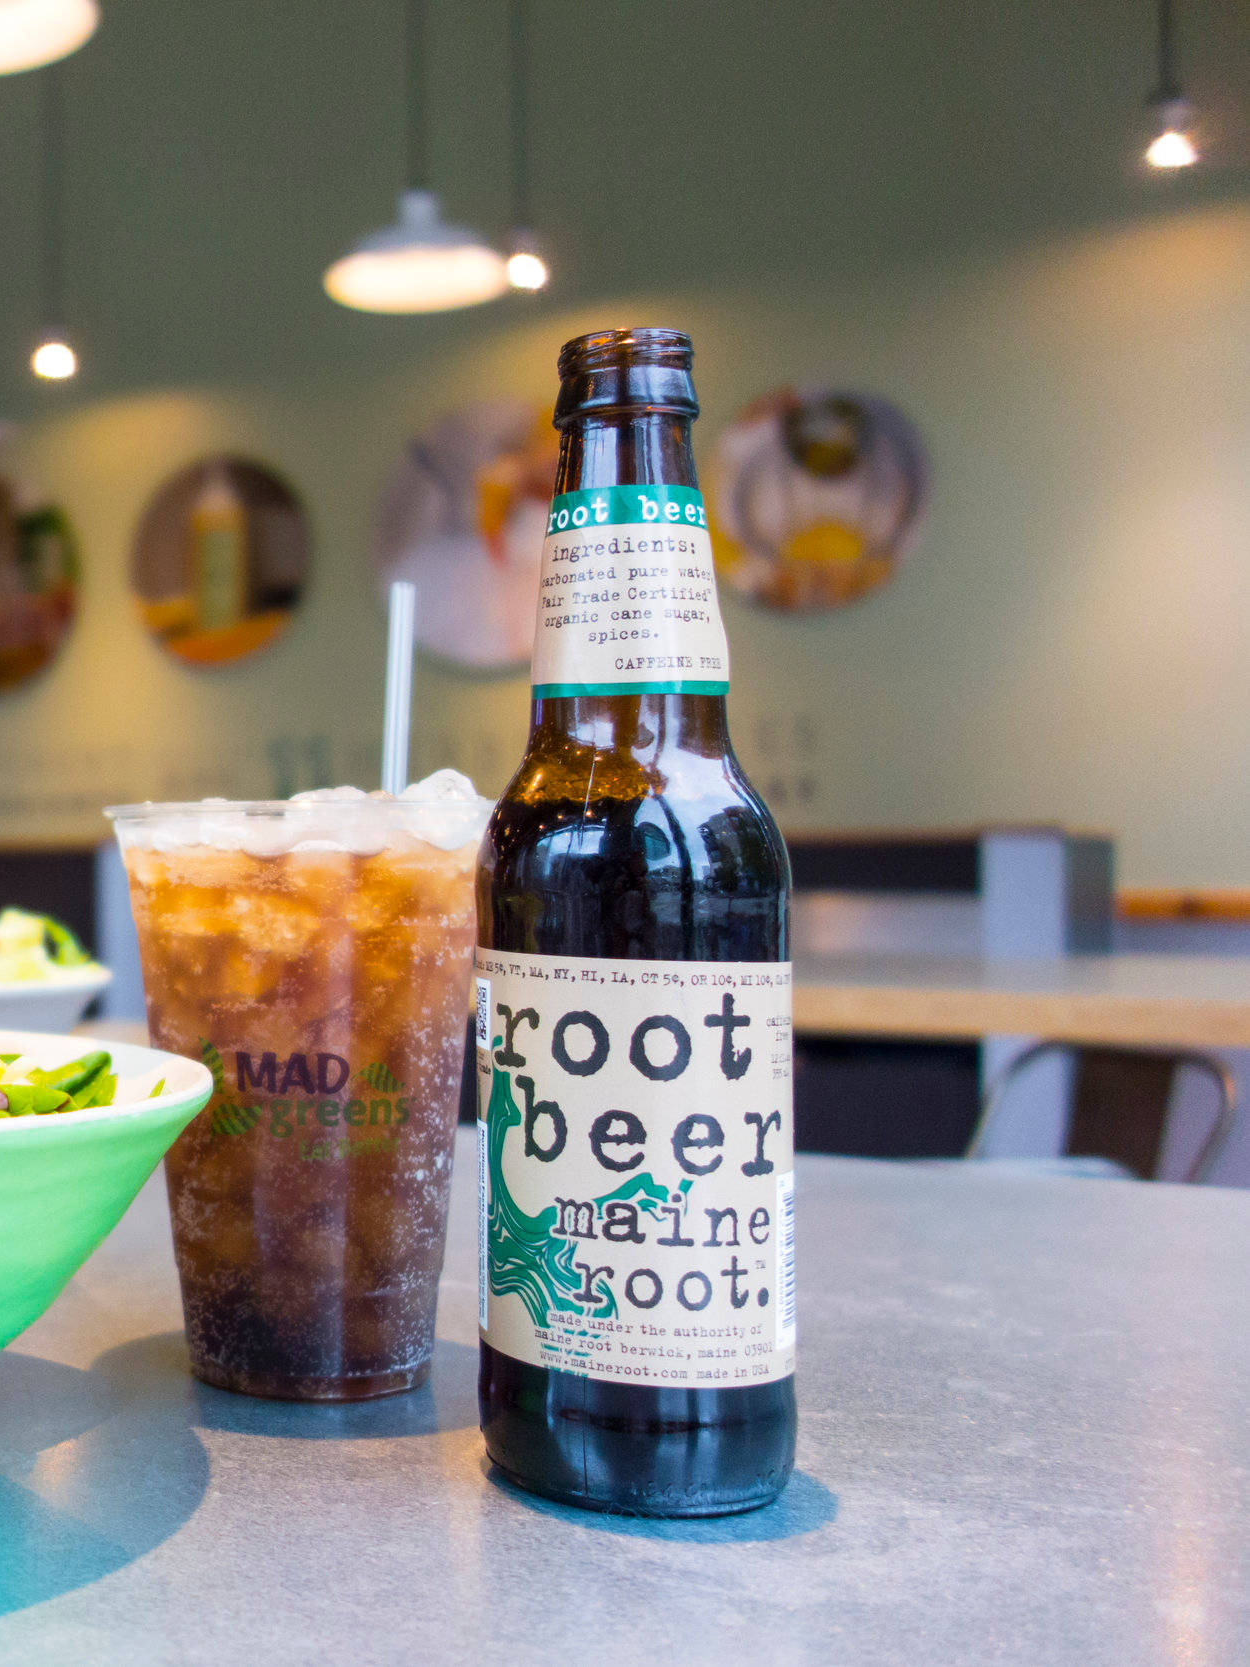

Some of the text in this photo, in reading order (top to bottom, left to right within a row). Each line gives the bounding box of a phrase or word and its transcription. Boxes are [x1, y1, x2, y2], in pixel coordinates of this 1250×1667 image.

[547, 495, 707, 532] root beer
[552, 537, 696, 563] ingredients:
[628, 567, 669, 581] pure
[572, 589, 620, 604] Trade
[544, 608, 710, 628] organic cane sugar,
[588, 628, 659, 645] spices.
[615, 656, 693, 670] CAFFEINE
[553, 968, 576, 983] NY,
[581, 970, 605, 984] HI,
[610, 971, 635, 986] IA,
[641, 972, 658, 984] CT
[691, 974, 708, 986] OR
[495, 992, 752, 1081] root
[235, 1051, 350, 1094] MAD
[269, 1097, 410, 1138] greens
[515, 1074, 781, 1177] beer
[552, 1193, 770, 1247] maine
[572, 1255, 770, 1311] root.
[550, 1312, 762, 1339] made under the authority of
[535, 1328, 572, 1345] maine
[579, 1340, 612, 1351] root
[620, 1342, 692, 1360] berwick,
[697, 1347, 737, 1358] maine
[539, 1350, 770, 1379] www.maineroot.com made in USA
